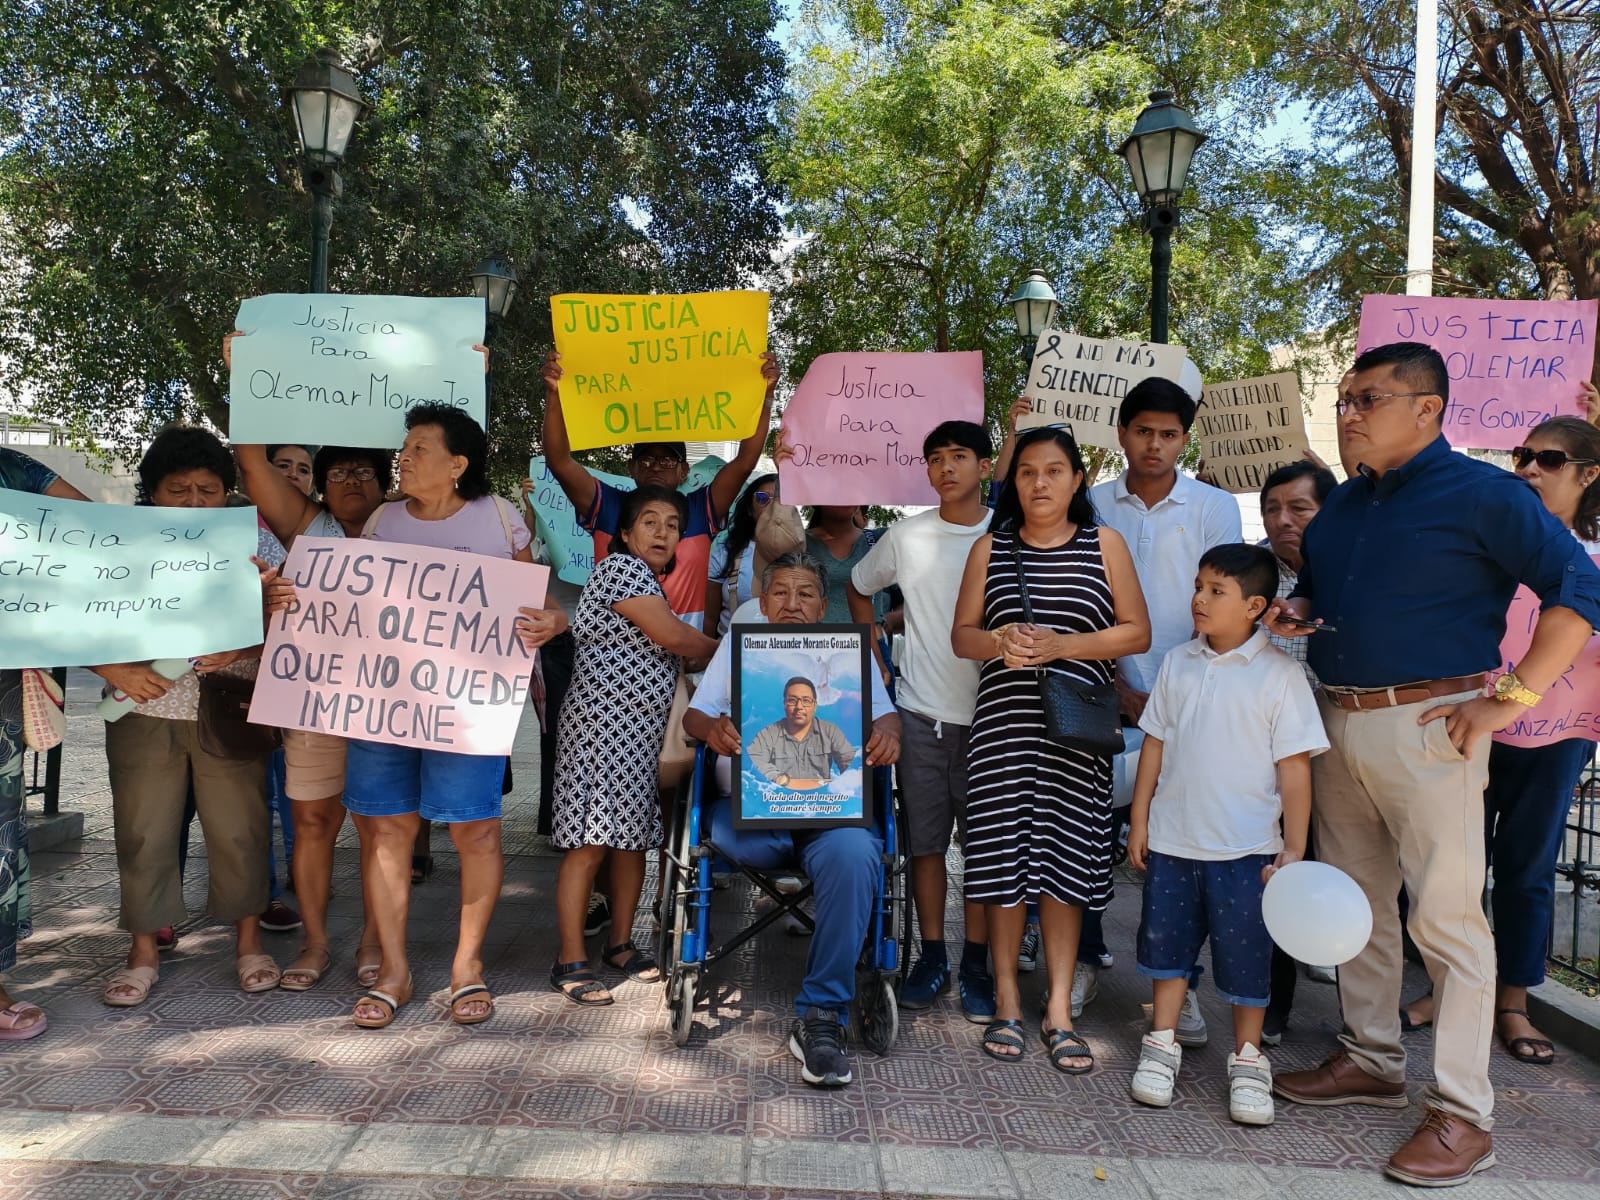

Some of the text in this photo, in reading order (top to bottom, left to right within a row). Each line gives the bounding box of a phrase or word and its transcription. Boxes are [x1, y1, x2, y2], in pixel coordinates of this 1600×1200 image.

[1391, 306, 1585, 345] JUSTICIA
[311, 336, 376, 360] Para
[1076, 343, 1155, 368] NO MÁS
[1446, 351, 1567, 382] OLEMAR
[574, 373, 632, 396] PARA
[1036, 364, 1129, 399] SILENCIO
[604, 391, 737, 434] OLEMAR
[1054, 400, 1101, 423] QUEDE
[1266, 406, 1290, 427] NO
[159, 527, 206, 543] su
[94, 565, 130, 580] no
[85, 595, 181, 619] impune
[378, 604, 530, 659] OLEMAR
[744, 637, 859, 649] Olemar Alexander Morante Gonzales
[270, 643, 530, 706] QUE NO QUEDE
[299, 690, 456, 745] IMPUCNE
[1493, 708, 1600, 737] ONZALES
[763, 792, 849, 803] Vuela alto mi negrito
[770, 803, 841, 814] te amaré siempre
